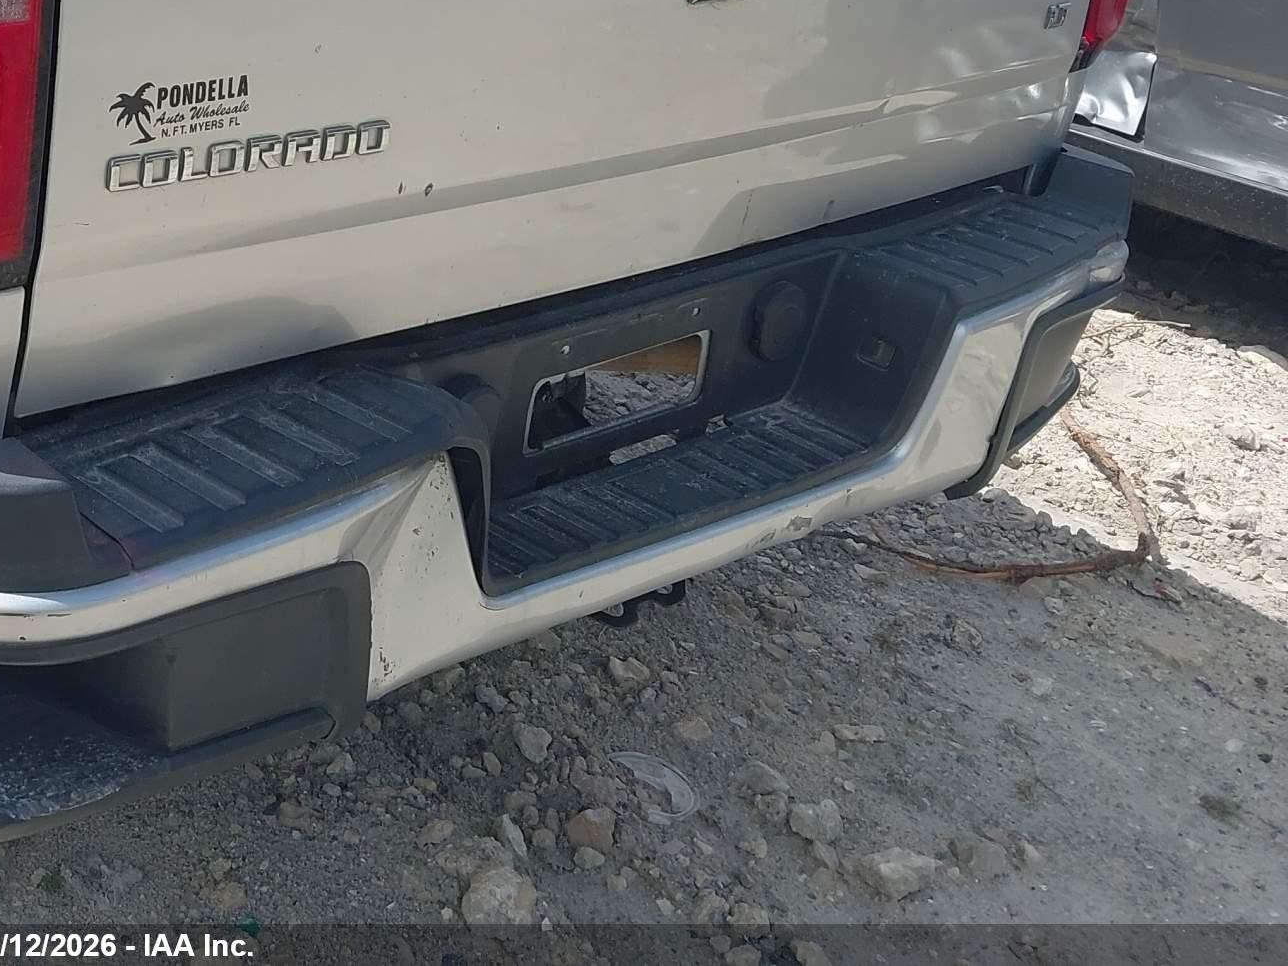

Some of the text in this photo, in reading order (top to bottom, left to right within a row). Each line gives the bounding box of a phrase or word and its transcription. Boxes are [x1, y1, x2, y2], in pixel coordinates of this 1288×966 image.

[157, 75, 249, 109] PONDELLA
[153, 102, 250, 127] Auto Wholesale
[189, 119, 224, 134] MYERS
[229, 117, 241, 127] FL
[104, 119, 391, 192] COLORADO
